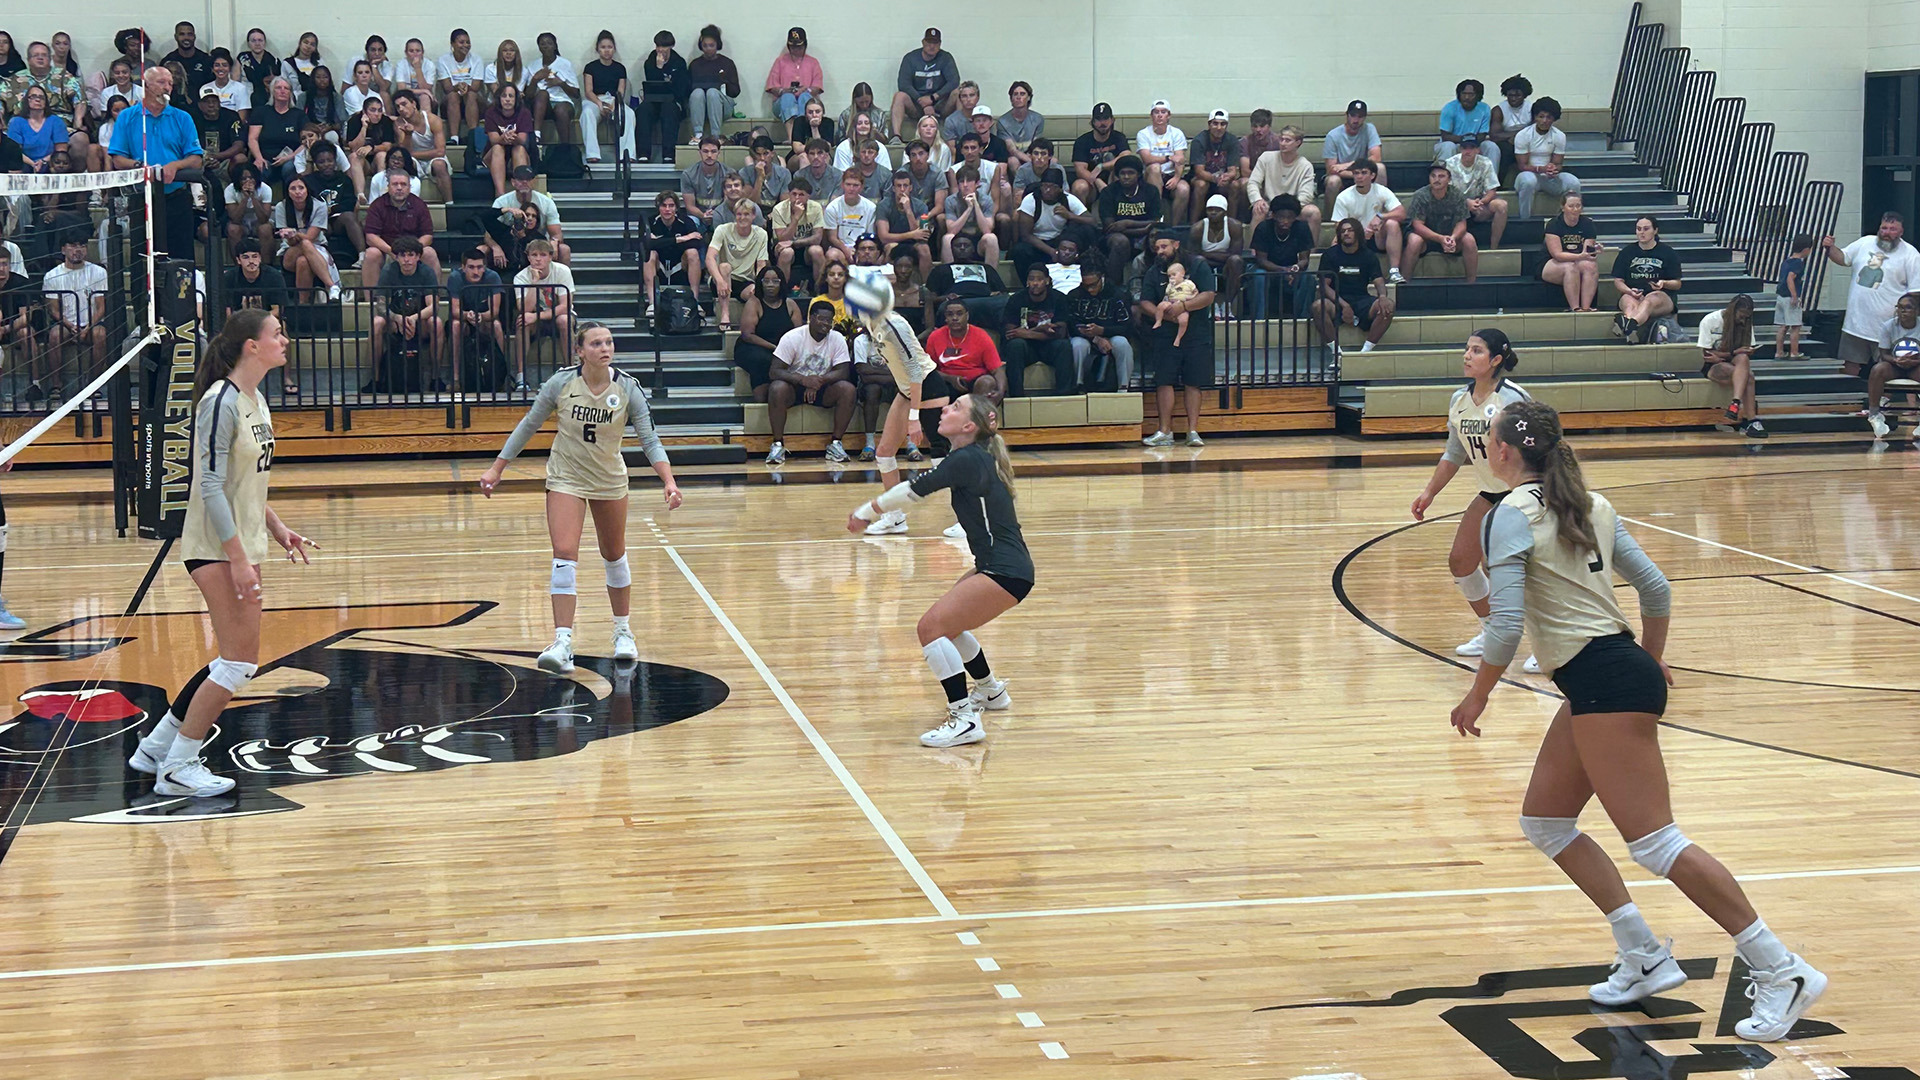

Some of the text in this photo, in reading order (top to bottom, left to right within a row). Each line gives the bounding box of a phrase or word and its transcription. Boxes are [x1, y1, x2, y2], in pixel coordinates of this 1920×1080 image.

[160, 319, 196, 521] VOLLEYBALL
[572, 404, 614, 424] FERRUM
[583, 424, 597, 444] 6
[257, 442, 274, 473] 20
[1467, 436, 1488, 460] 14
